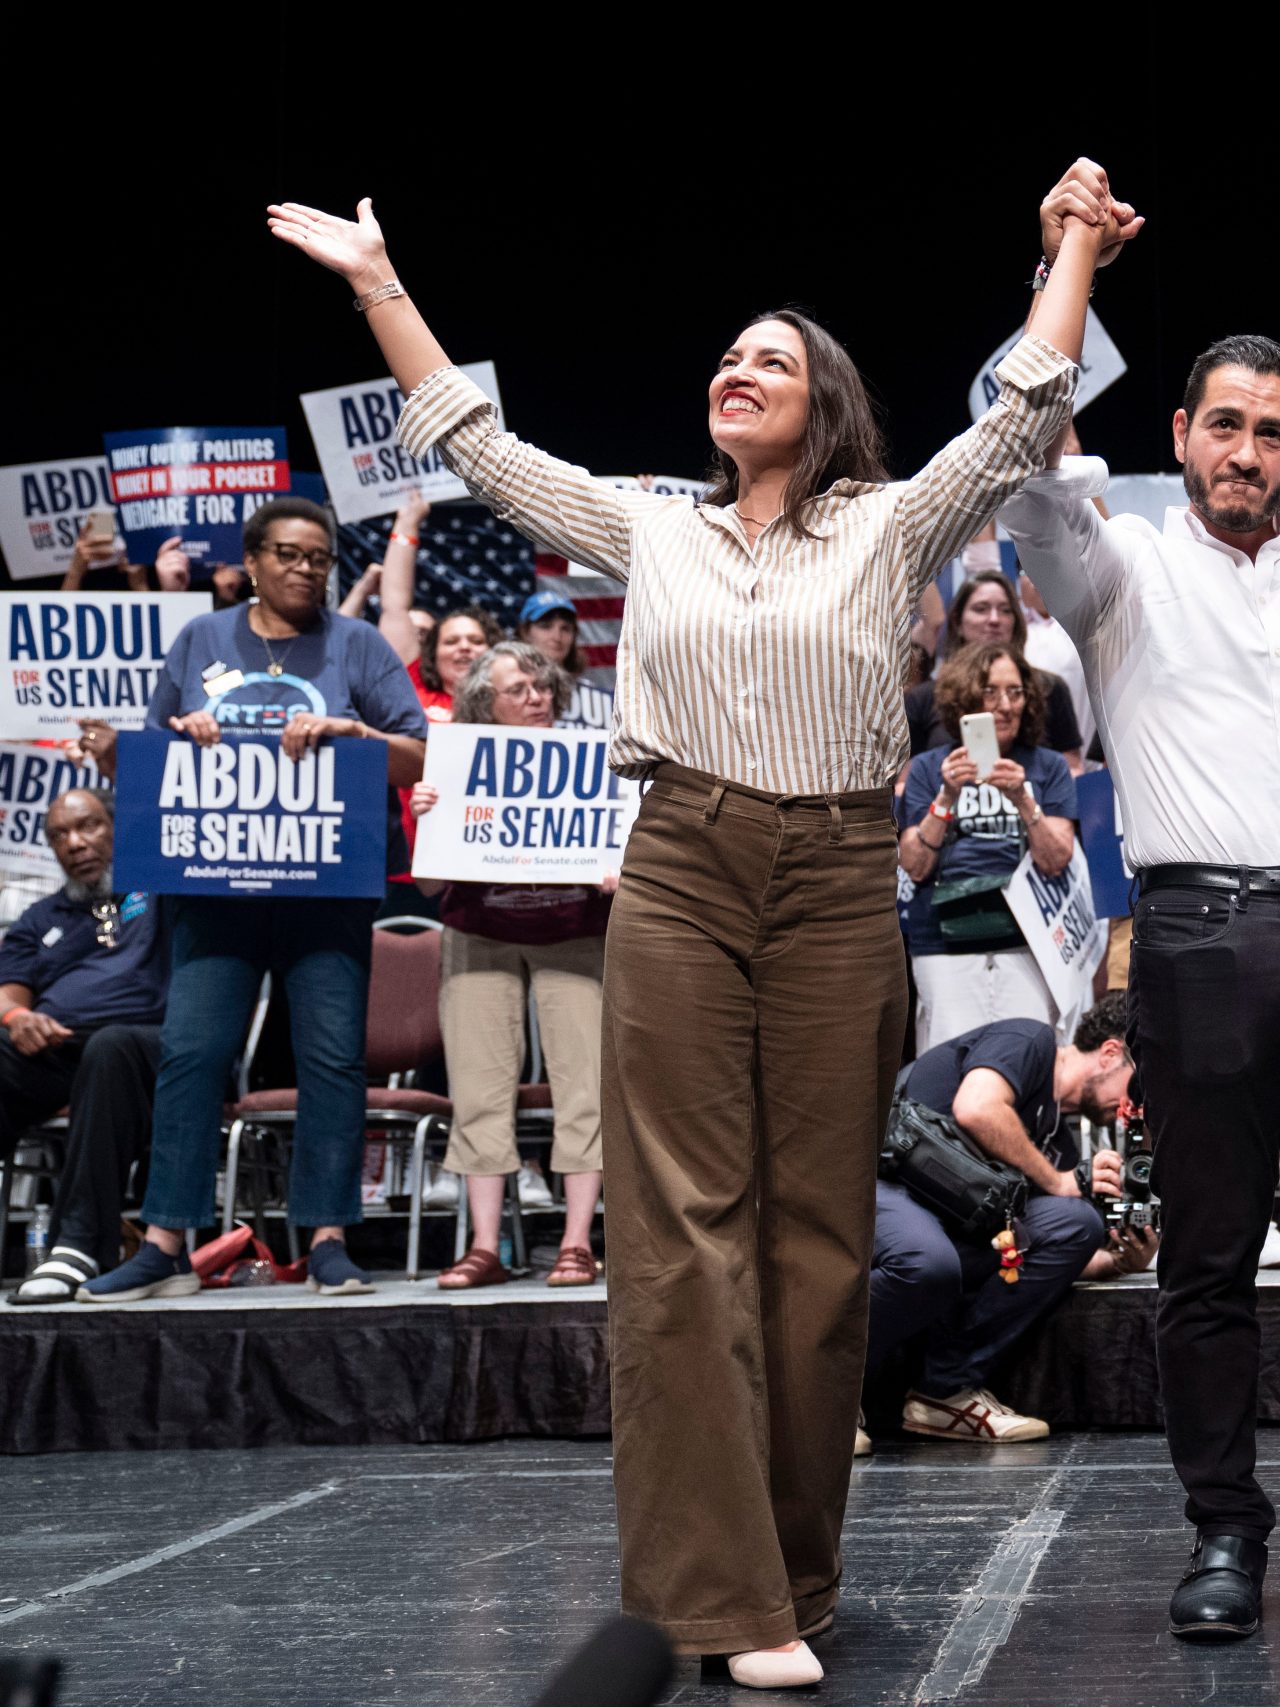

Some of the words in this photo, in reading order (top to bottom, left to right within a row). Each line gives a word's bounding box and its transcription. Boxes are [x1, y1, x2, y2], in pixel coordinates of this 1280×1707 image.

[203, 438, 275, 462] POLITICS
[214, 465, 276, 488] POCKET
[358, 466, 379, 487] US
[22, 466, 117, 518] ABD
[196, 494, 236, 525] FOR
[9, 603, 166, 661] ABDUL
[12, 669, 39, 687] FOR
[46, 668, 163, 708] SENAT
[16, 685, 42, 706] US
[158, 740, 345, 813] ABDUL
[465, 737, 628, 801] ABDUL
[161, 814, 196, 835] FOR
[464, 806, 494, 823] FOR
[200, 812, 342, 863] SENATE
[463, 823, 492, 844] US
[499, 805, 622, 850] SENATE
[161, 833, 196, 858] US
